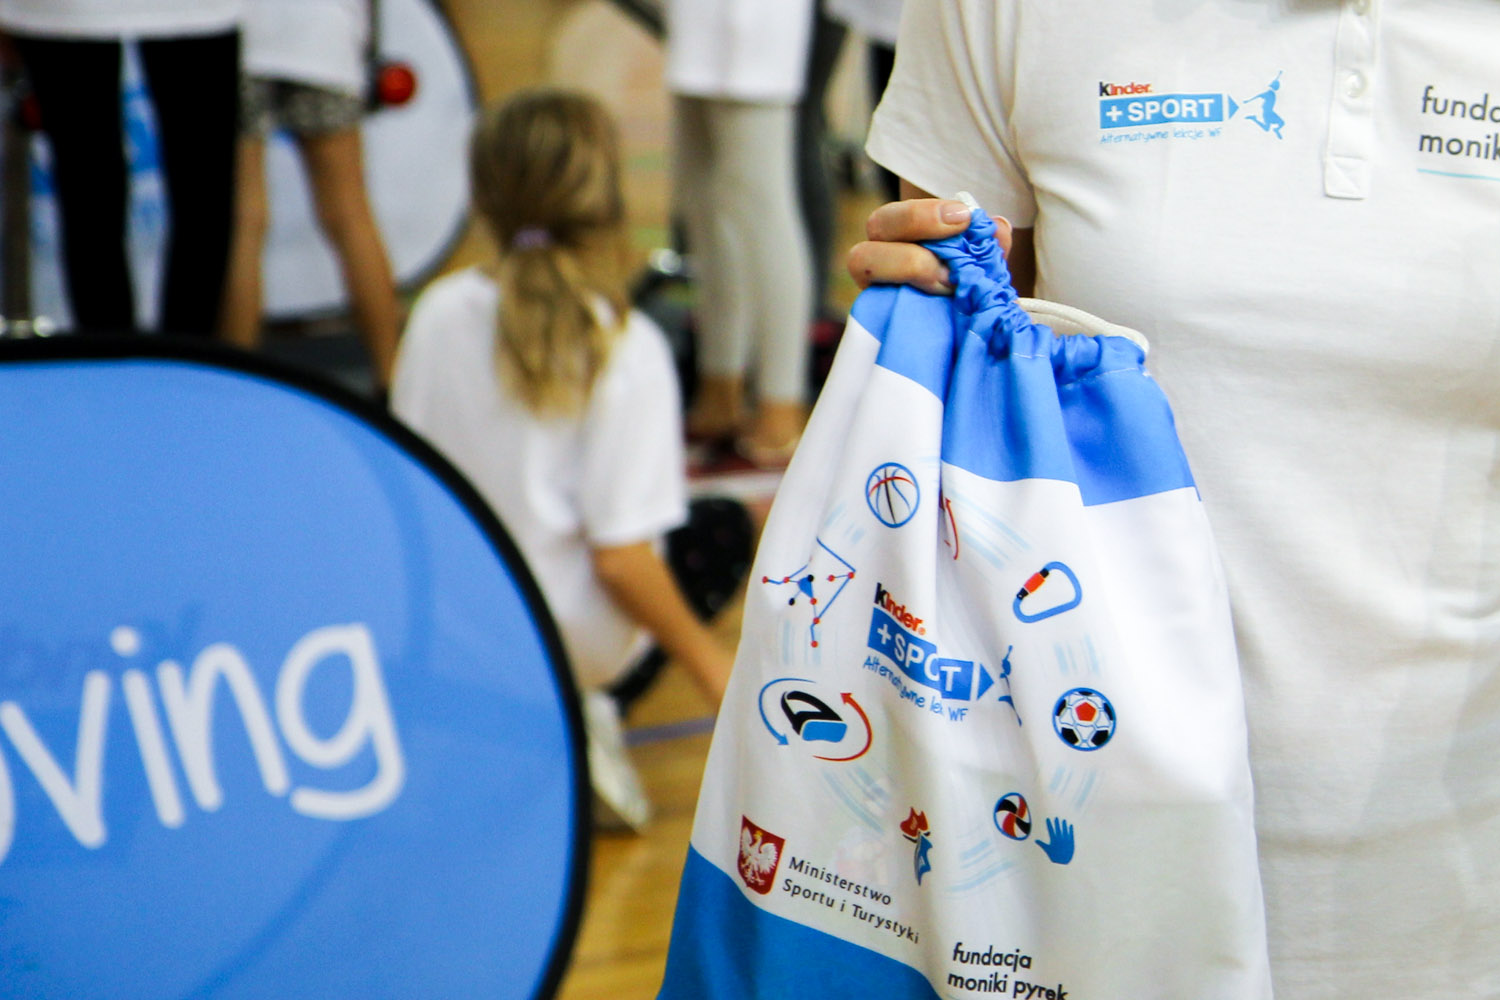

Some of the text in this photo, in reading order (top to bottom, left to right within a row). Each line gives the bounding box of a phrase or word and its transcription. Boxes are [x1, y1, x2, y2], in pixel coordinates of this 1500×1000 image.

[947, 707, 969, 722] WF
[0, 622, 404, 864] ving
[788, 856, 892, 906] Ministerstwo
[782, 878, 920, 945] Sportu i Turystyki
[952, 941, 1033, 973] fundacja
[947, 971, 1069, 1000] moniki pyrek
